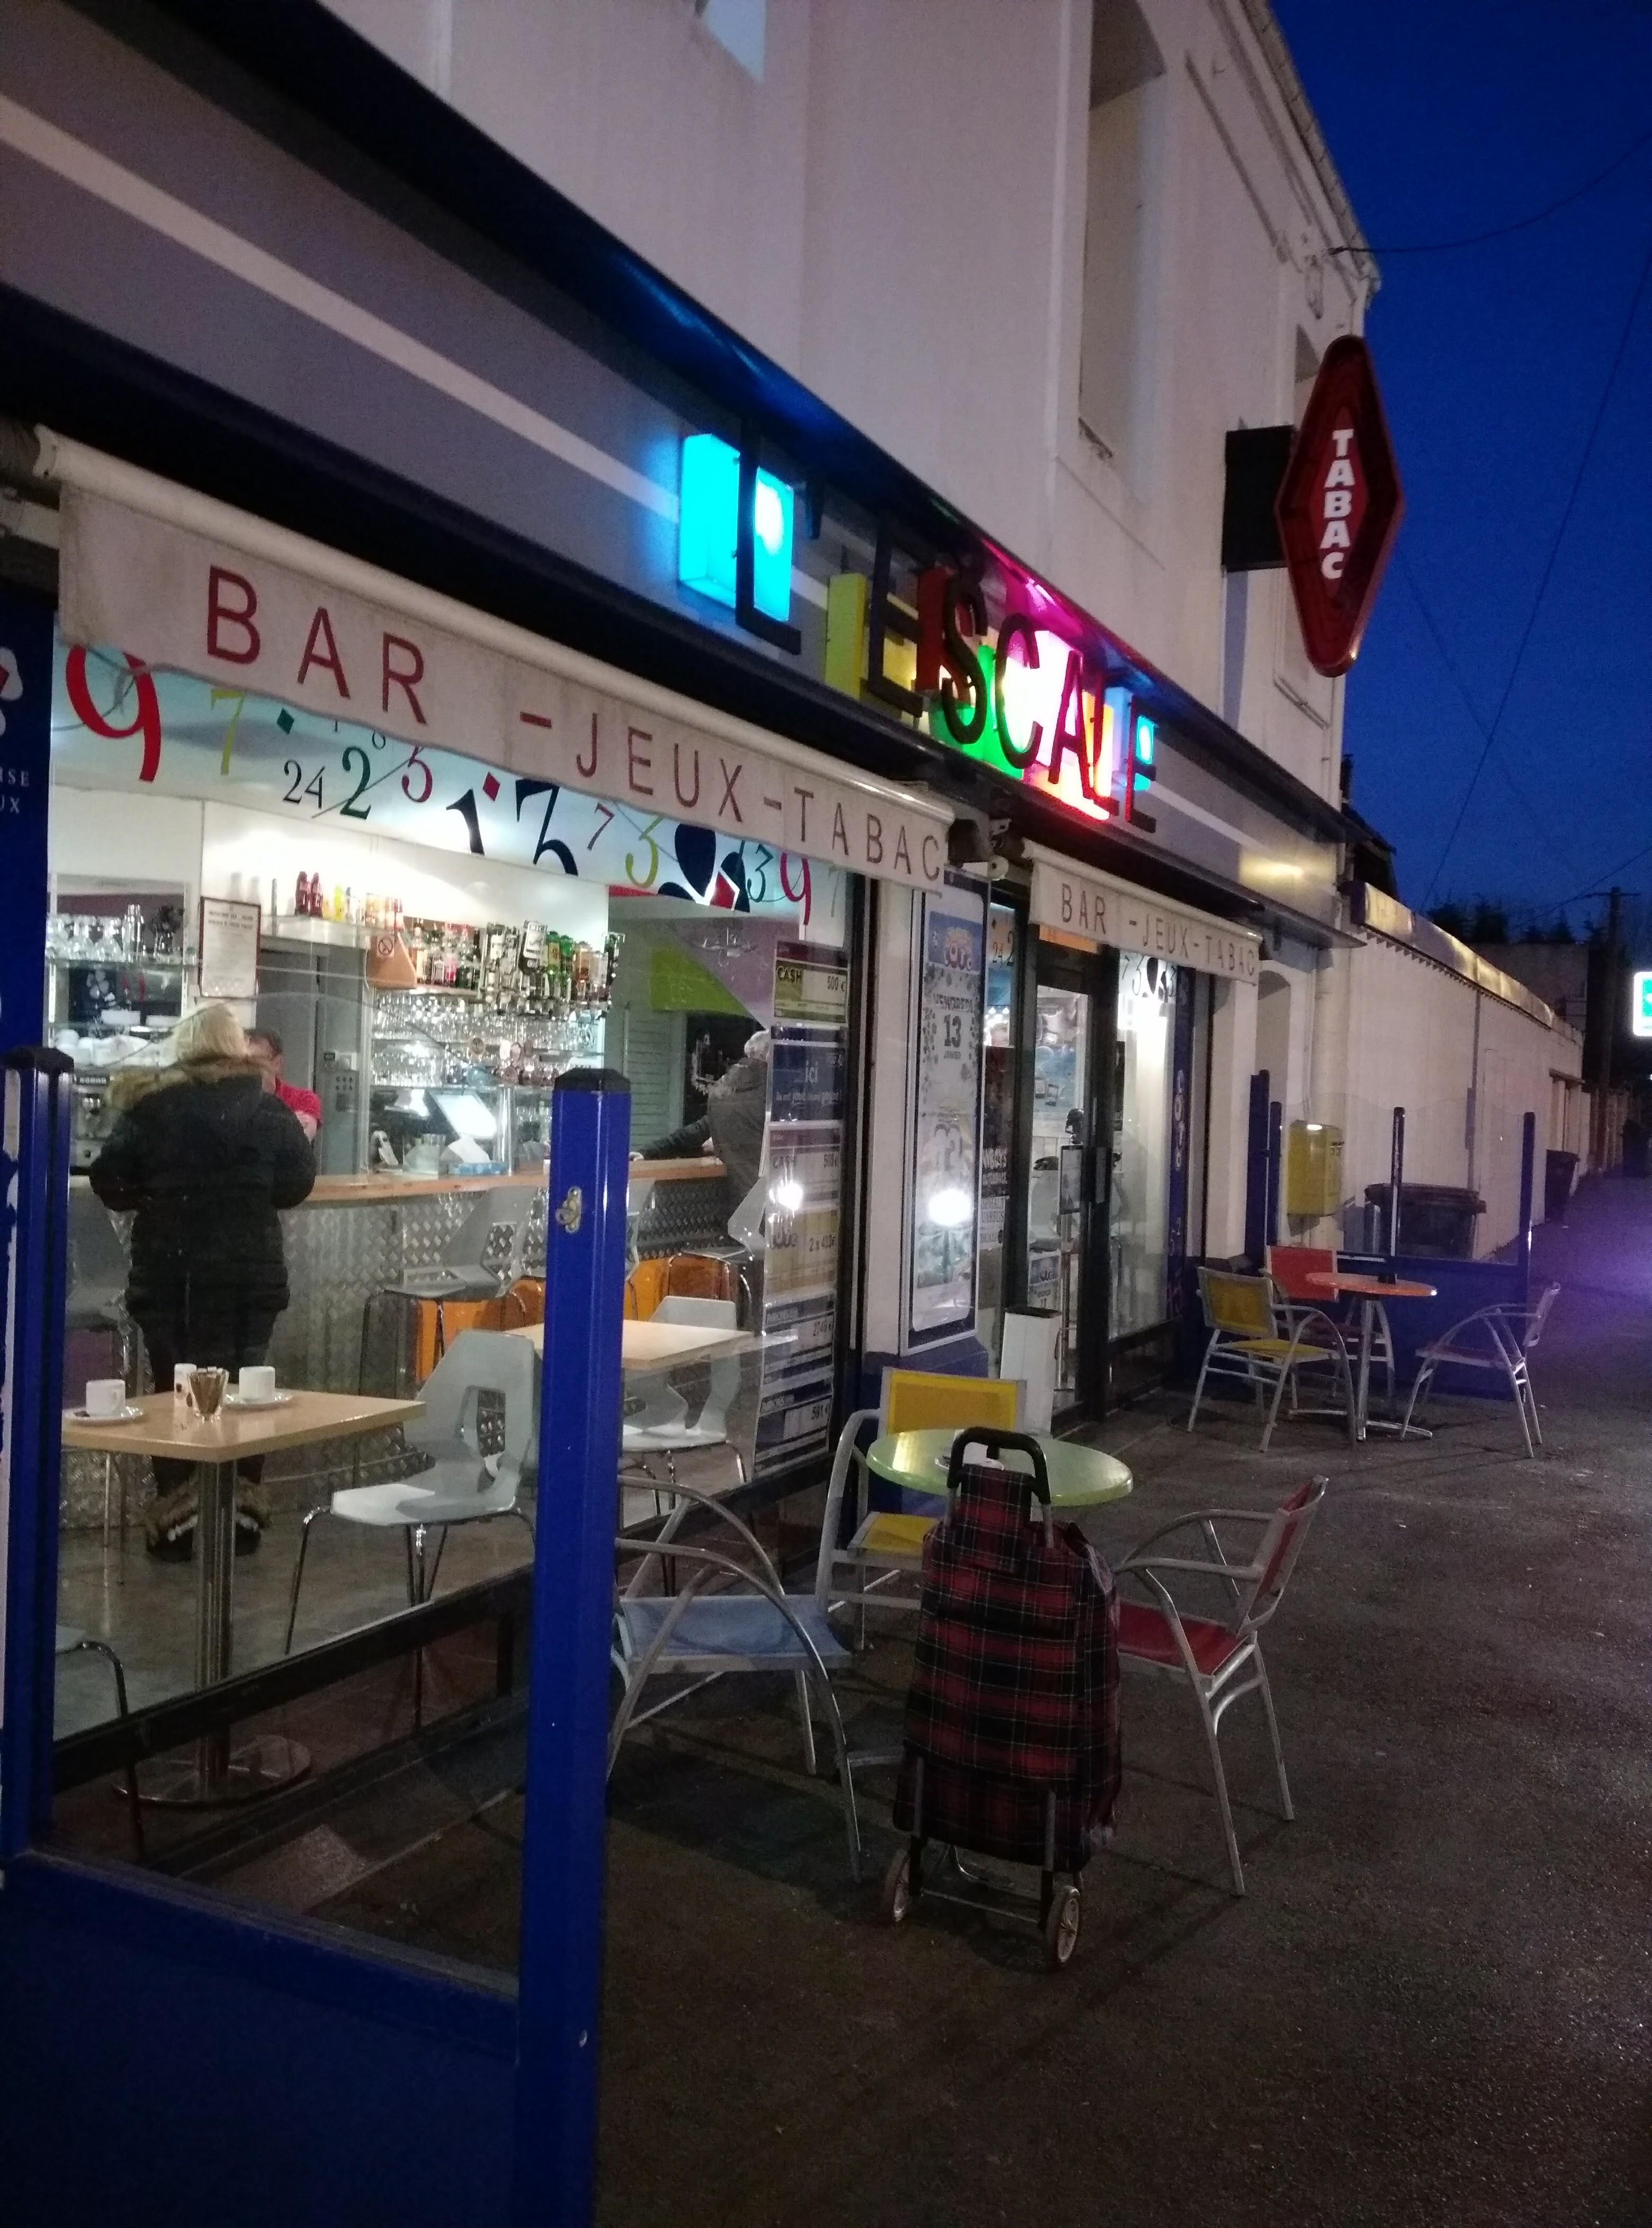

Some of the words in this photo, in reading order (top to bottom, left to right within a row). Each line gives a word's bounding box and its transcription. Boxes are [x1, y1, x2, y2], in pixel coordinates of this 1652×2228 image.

[1319, 428, 1354, 579] TABAC
[206, 564, 427, 725] BAR
[339, 741, 371, 820] 2
[587, 803, 615, 850] 7
[1061, 883, 1107, 935] BAR
[777, 965, 802, 984] CASH
[944, 1014, 962, 1048] 13
